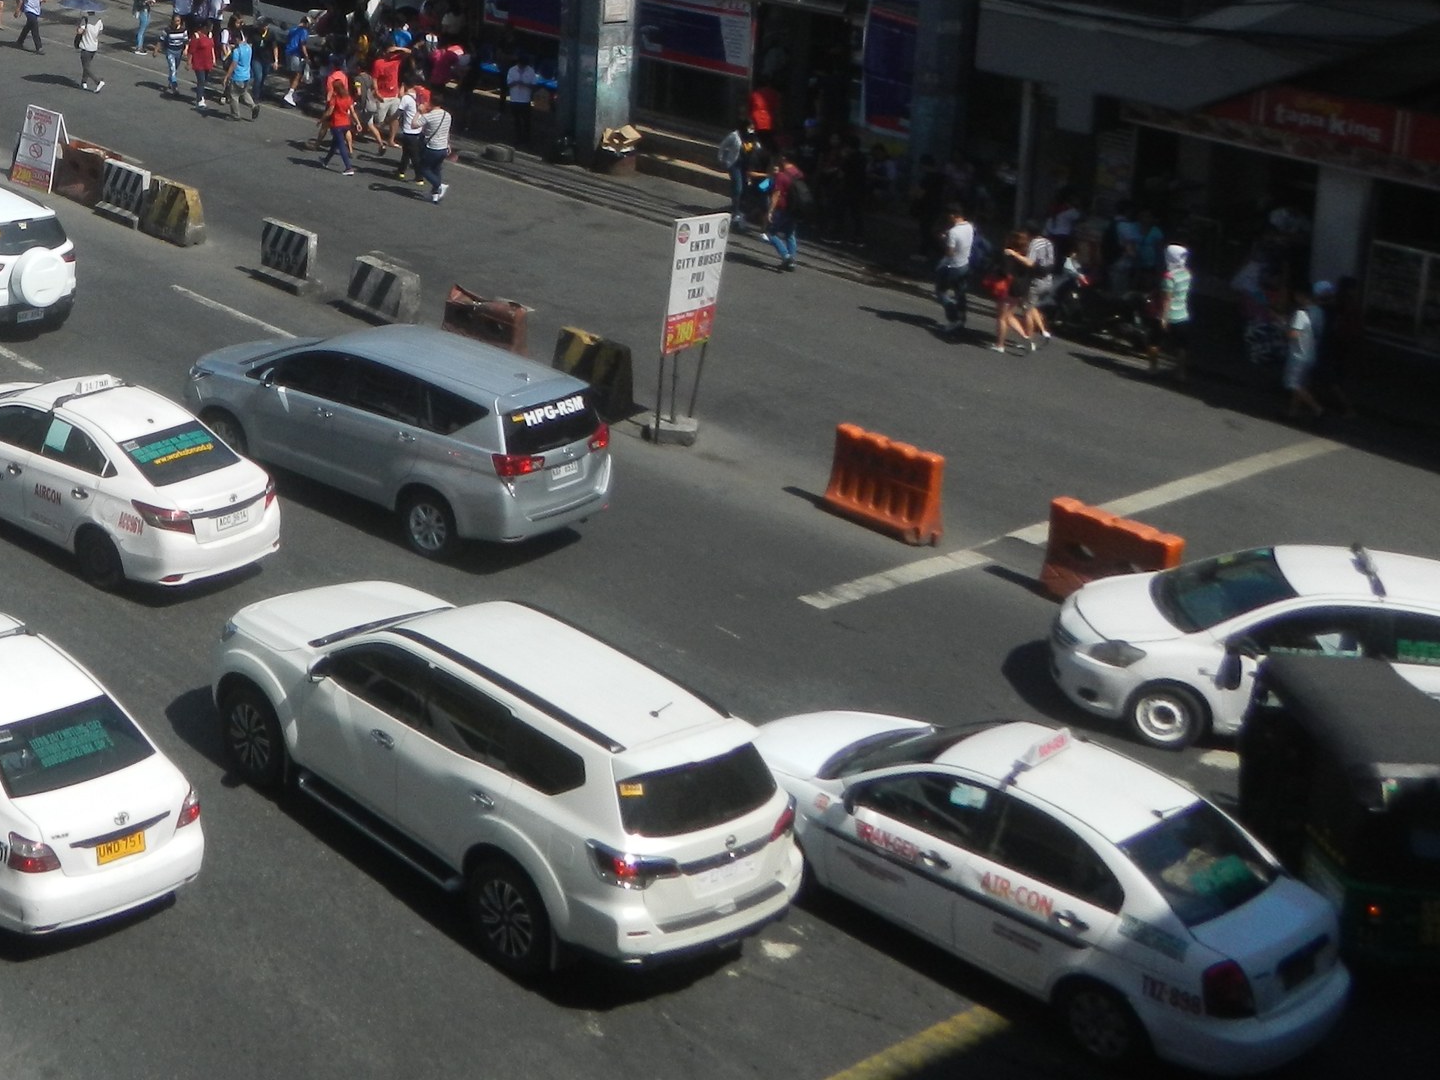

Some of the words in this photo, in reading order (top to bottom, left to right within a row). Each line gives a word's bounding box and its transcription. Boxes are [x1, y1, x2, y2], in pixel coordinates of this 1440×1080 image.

[698, 223, 710, 235] NO
[689, 238, 716, 253] ENTRY
[675, 256, 697, 271] CITY
[697, 251, 723, 268] BUSES
[690, 271, 705, 283] PUJ
[687, 286, 705, 300] TAXI
[522, 395, 585, 427] HPG-RSM
[34, 482, 62, 505] AIRCON
[123, 834, 142, 849] 751
[980, 871, 1055, 917] AIR-CON
